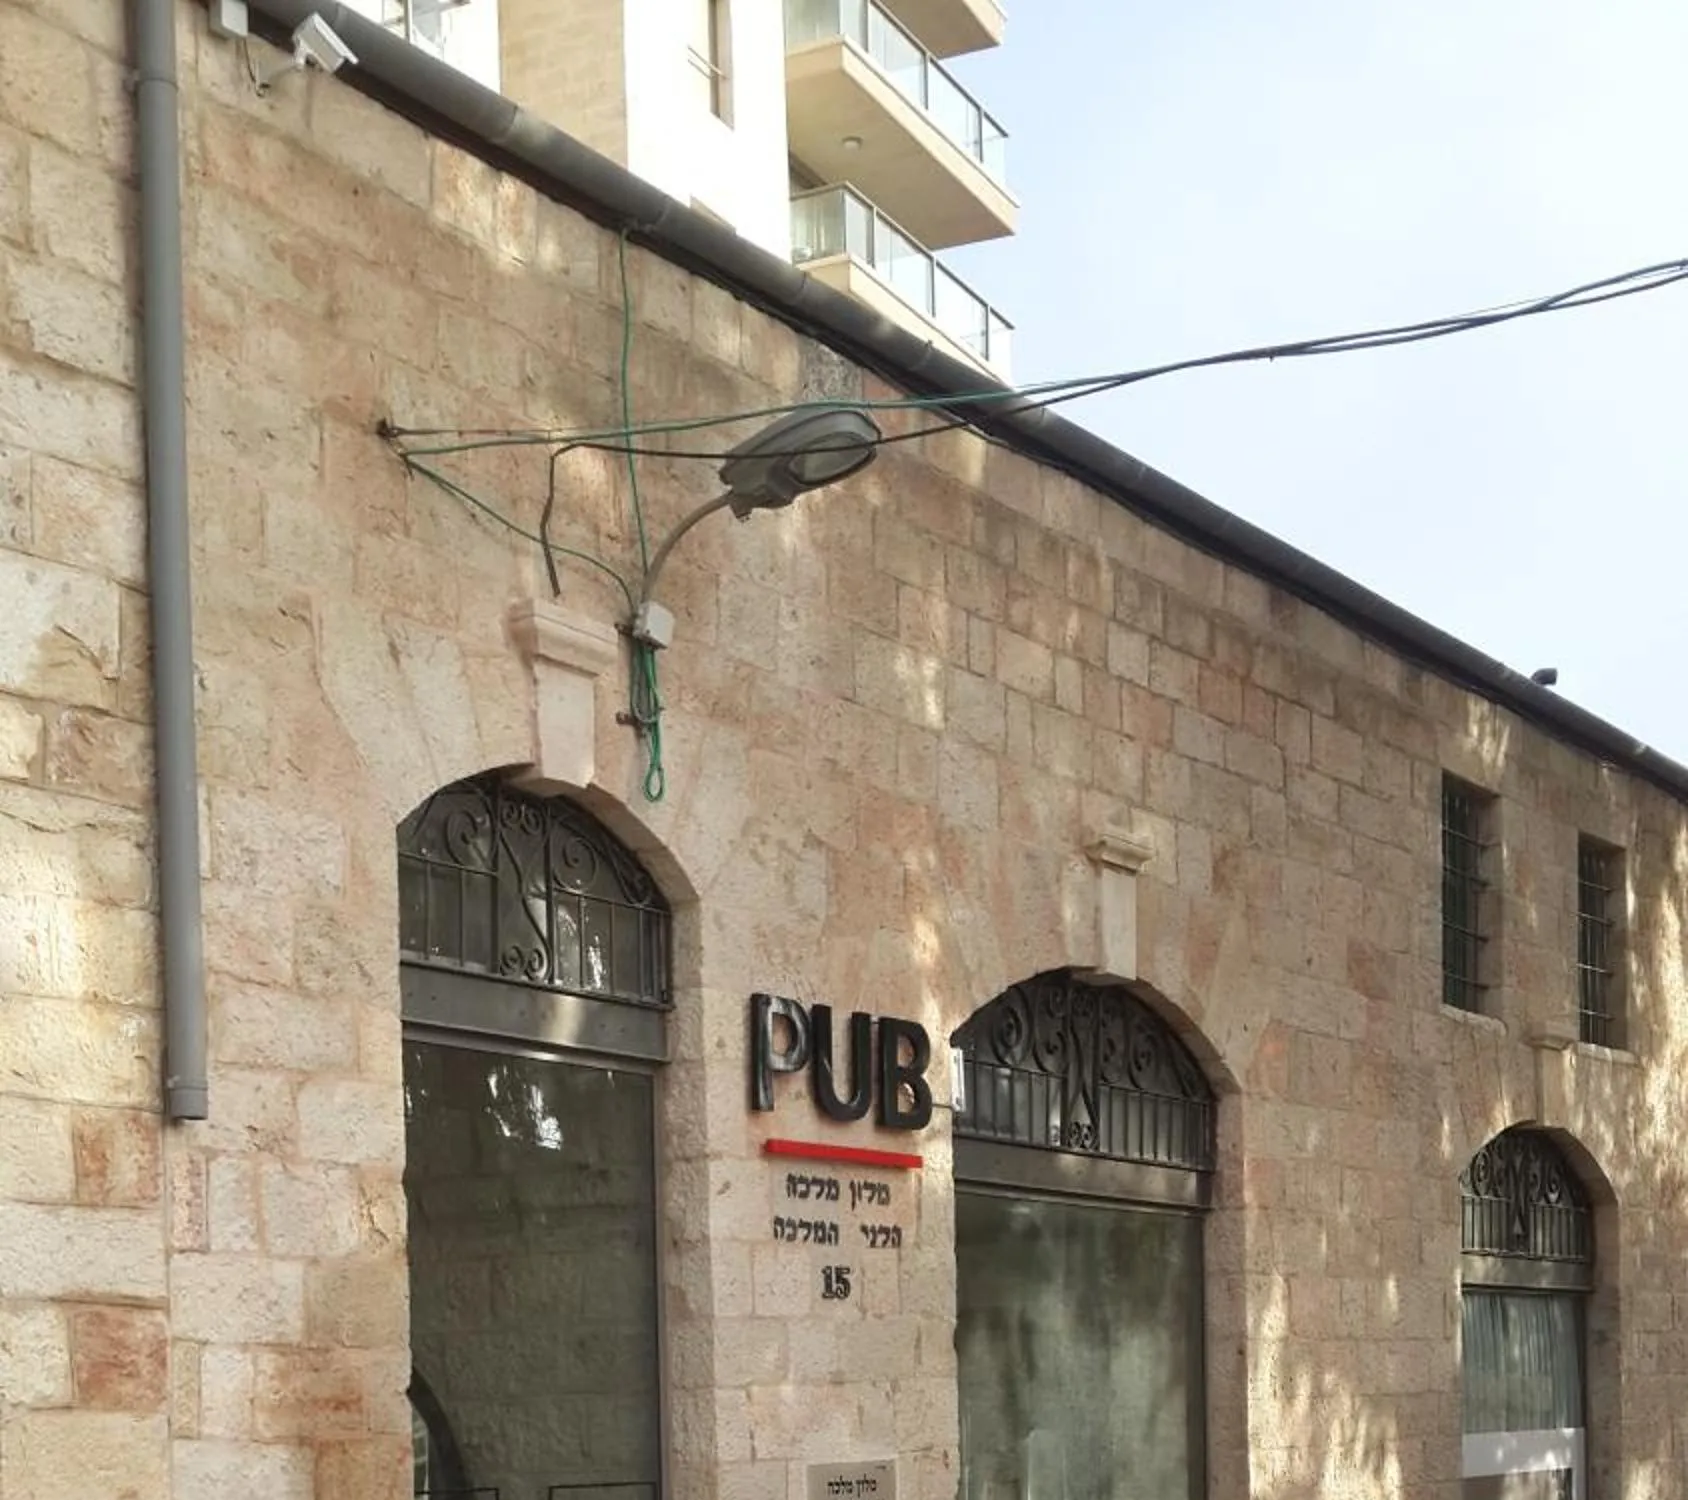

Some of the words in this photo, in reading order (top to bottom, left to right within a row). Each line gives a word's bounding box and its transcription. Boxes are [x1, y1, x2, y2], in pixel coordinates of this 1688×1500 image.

[750, 993, 932, 1130] PUB
[786, 1173, 839, 1201] מלכה
[849, 1180, 890, 1210] מלון
[773, 1215, 839, 1246] המלכה
[860, 1224, 902, 1249] הלני
[821, 1265, 850, 1298] 15
